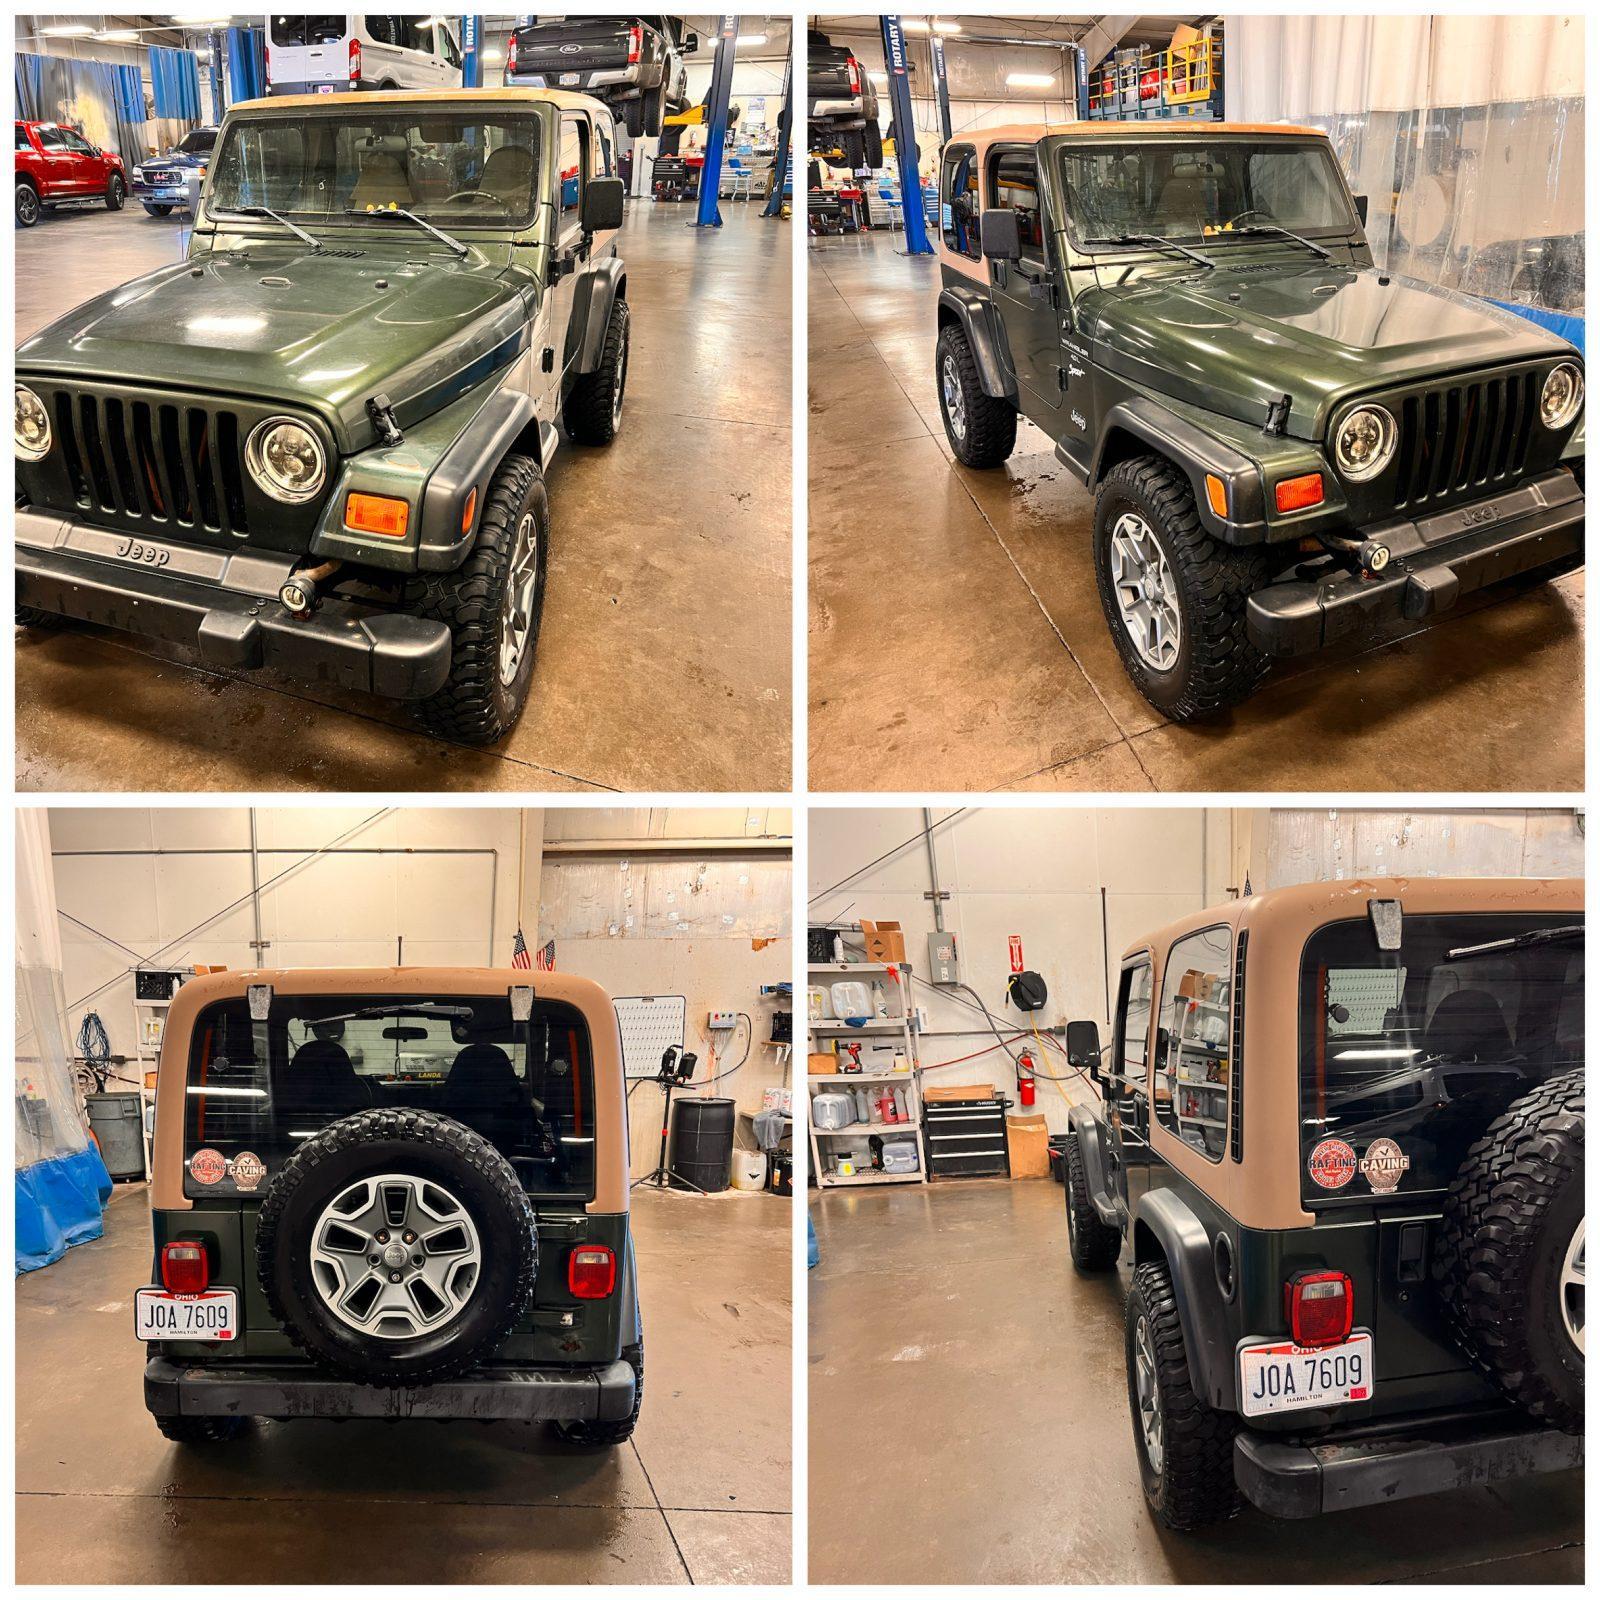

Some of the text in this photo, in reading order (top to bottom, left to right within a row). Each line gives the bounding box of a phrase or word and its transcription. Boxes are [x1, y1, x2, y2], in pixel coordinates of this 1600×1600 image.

[889, 23, 903, 67] ROTARY
[1070, 408, 1087, 431] Jeep
[1461, 506, 1503, 527] Jeep
[115, 537, 170, 567] Jeep
[192, 1162, 226, 1170] RAFTING
[229, 1166, 266, 1175] CAVING
[1310, 1157, 1357, 1169] RAFTING
[1361, 1157, 1408, 1171] CAVING
[144, 1305, 228, 1328] JOA 7609
[1252, 1355, 1362, 1399] JOA 7609
[1286, 1394, 1323, 1403] HAMILTON
